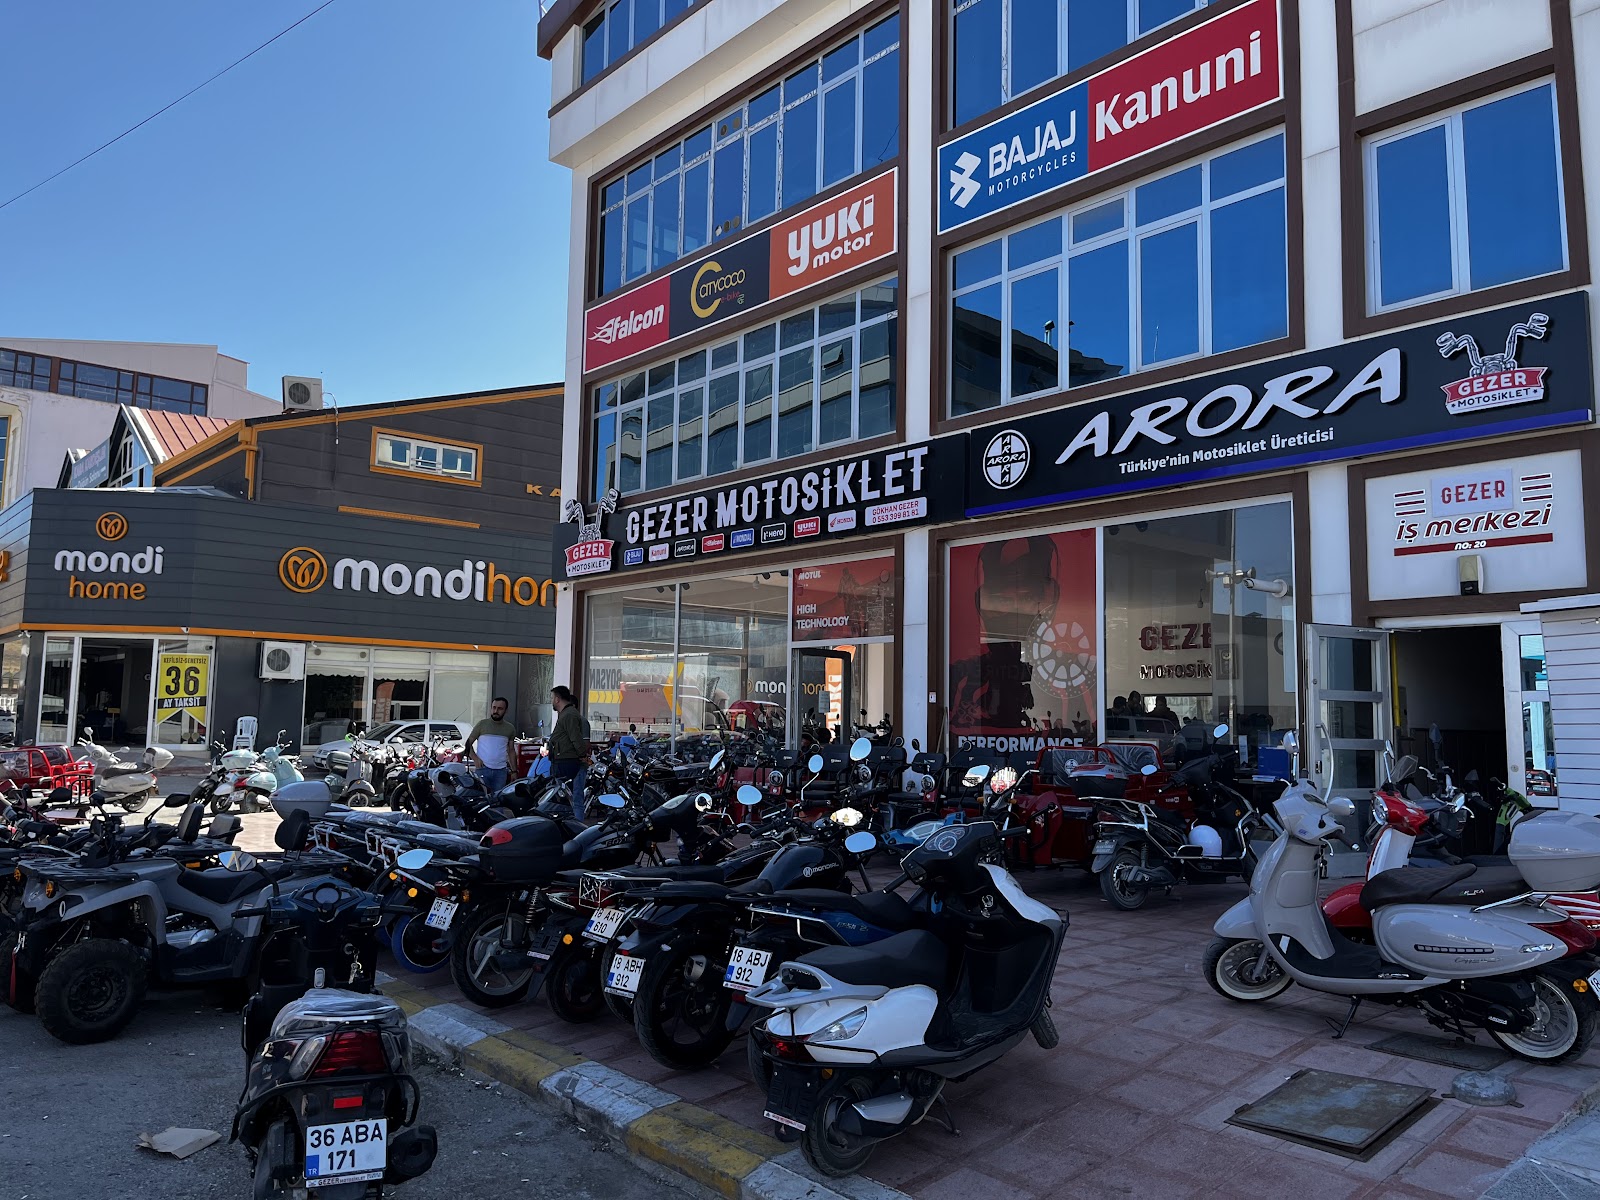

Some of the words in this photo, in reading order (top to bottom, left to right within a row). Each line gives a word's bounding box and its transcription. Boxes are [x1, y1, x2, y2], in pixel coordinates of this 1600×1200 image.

[1095, 30, 1261, 142] Kanuni
[988, 110, 1077, 179] BAJAJ
[988, 151, 1077, 197] MOTORCYCLES
[812, 230, 874, 269] motor
[1458, 372, 1527, 396] GEZER
[1054, 348, 1401, 464] ARORA
[1192, 438, 1267, 462] Motosiklet
[1270, 427, 1335, 450] Üreticisi
[987, 452, 1026, 465] ARORA
[1441, 480, 1505, 504] GEZER
[872, 503, 898, 516] GÖKHAN
[899, 500, 919, 511] GEZER
[625, 496, 707, 544] GEZER
[1424, 504, 1552, 538] merkezi
[572, 543, 605, 560] GEZER
[1474, 541, 1487, 549] 20
[54, 545, 165, 574] mondi
[798, 570, 821, 580] MOTUL
[69, 575, 147, 600] home
[796, 604, 816, 615] HIGH
[796, 616, 849, 629] TECHNOLOGY
[165, 666, 200, 696] 36
[163, 698, 173, 708] AY
[593, 921, 608, 934] 610
[613, 956, 623, 970] 18
[623, 960, 643, 975] ABH
[733, 948, 744, 963] 18
[745, 951, 769, 968] ABJ
[615, 973, 630, 988] 912
[735, 966, 753, 983] 912
[310, 1128, 335, 1149] 36
[341, 1122, 383, 1146] ABA
[327, 1149, 356, 1171] 171
[308, 1168, 318, 1176] TR
[318, 1177, 340, 1187] GEZER
